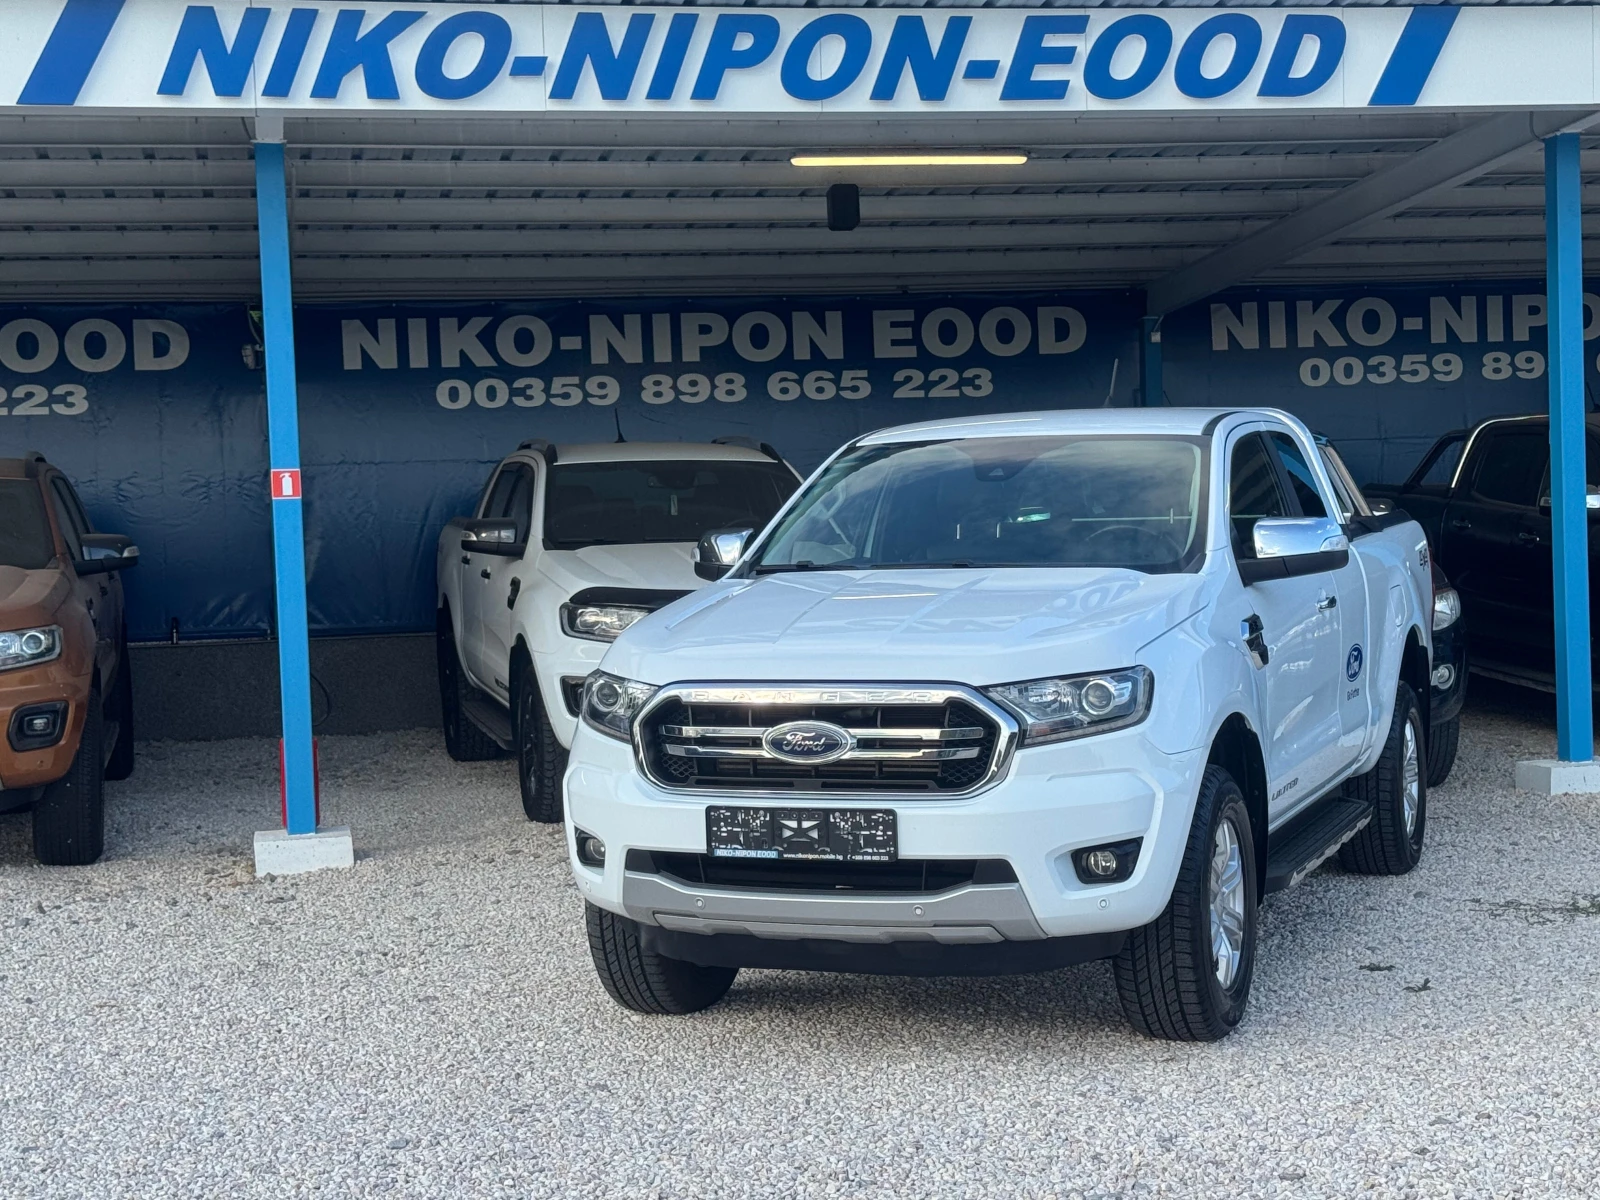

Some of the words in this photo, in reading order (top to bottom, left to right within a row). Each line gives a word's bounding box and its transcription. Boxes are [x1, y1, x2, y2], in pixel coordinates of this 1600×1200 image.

[157, 6, 1346, 101] NIKO-NIPON-EOOD
[341, 310, 845, 371] NIKO-NIPON
[873, 305, 1087, 359] EOOD
[1300, 352, 1463, 386] 00359
[1481, 350, 1545, 380] 89
[0, 384, 89, 416] 23
[436, 376, 620, 408] 00359
[641, 372, 747, 404] 898
[767, 369, 871, 401] 665
[892, 367, 994, 398] 223
[692, 690, 933, 702] RANGER
[782, 731, 826, 752] Ford
[716, 849, 757, 857] NIKO-NIPON
